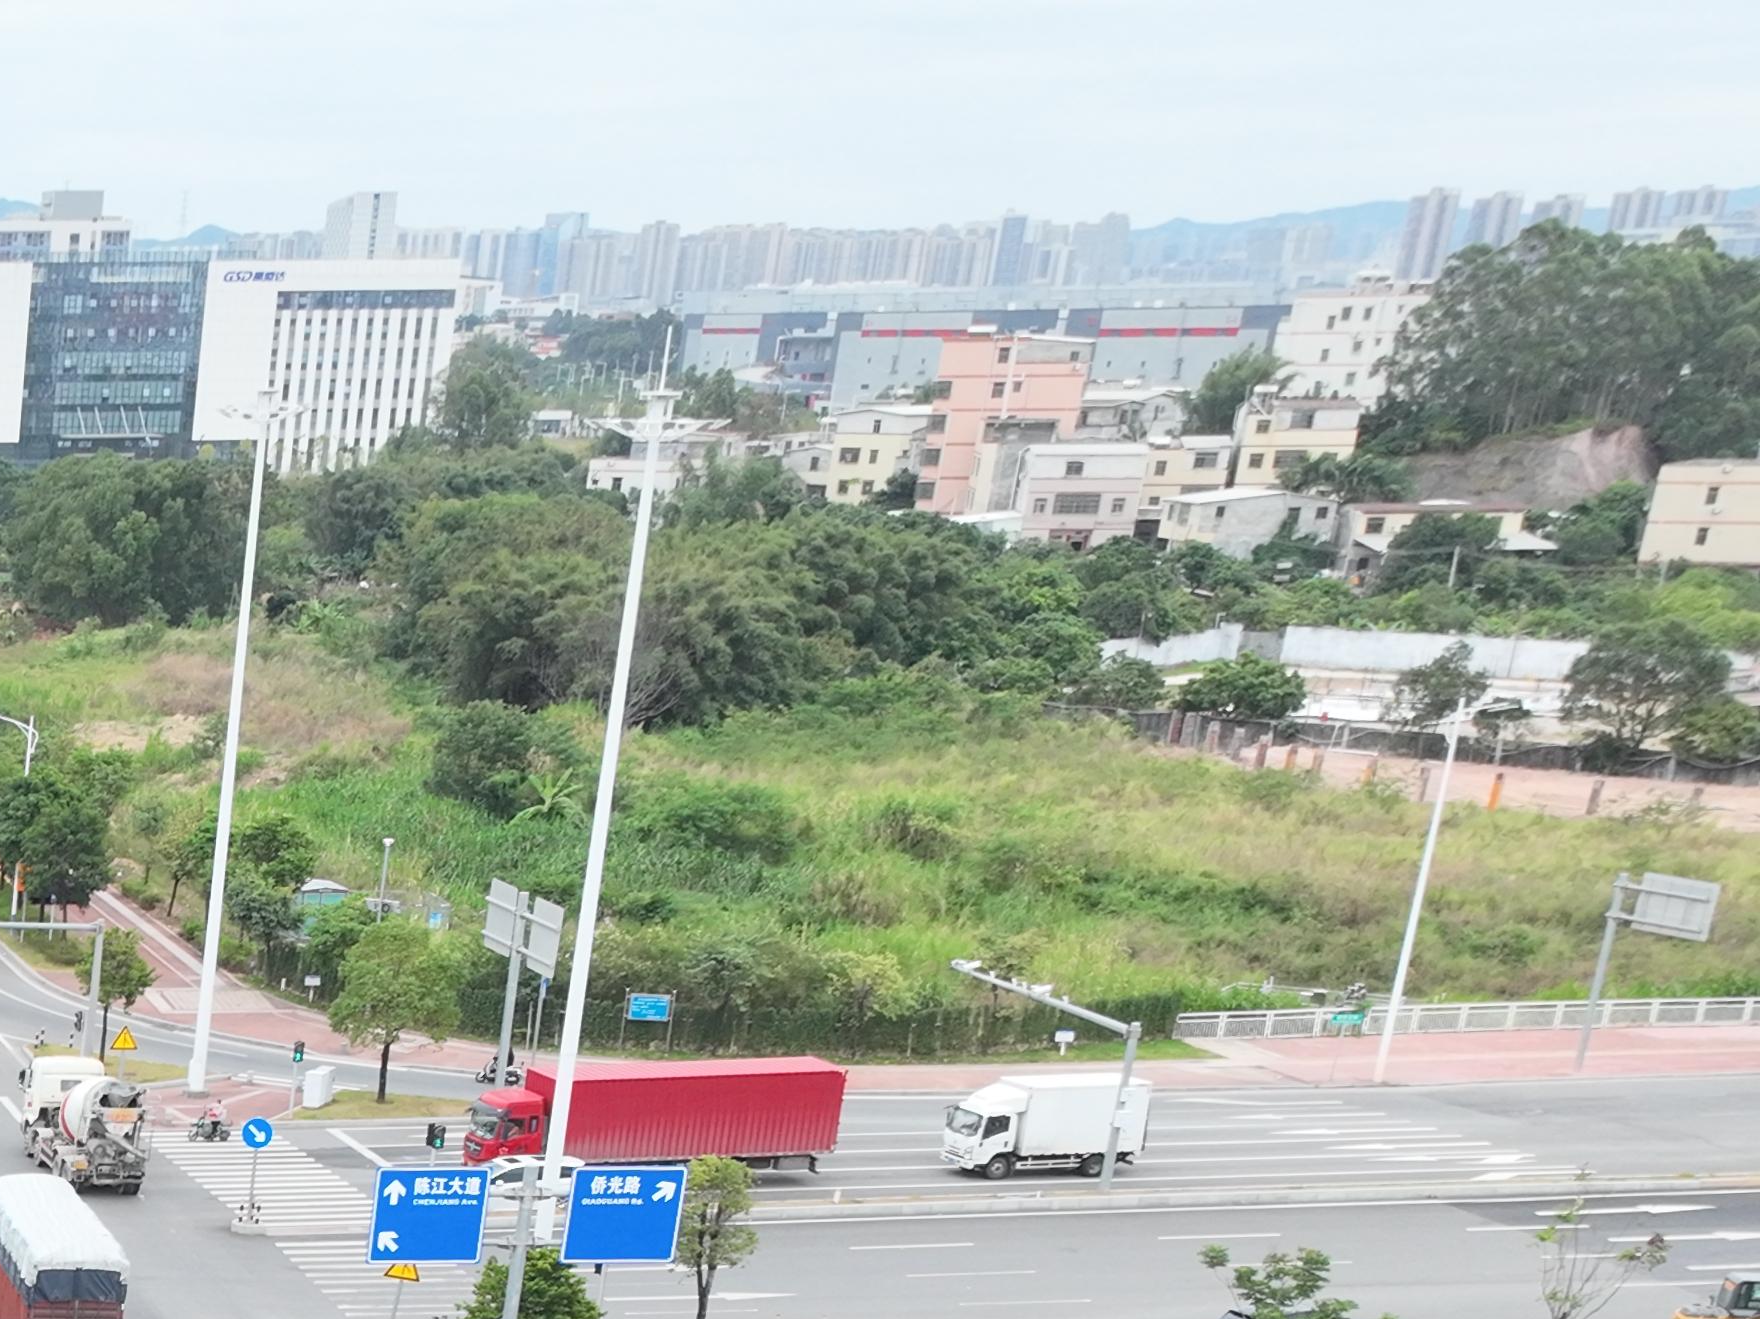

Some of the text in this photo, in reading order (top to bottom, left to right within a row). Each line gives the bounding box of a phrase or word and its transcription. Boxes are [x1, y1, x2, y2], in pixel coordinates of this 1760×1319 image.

[413, 1176, 481, 1196] 陈江大道
[591, 1175, 641, 1195] 侨光路
